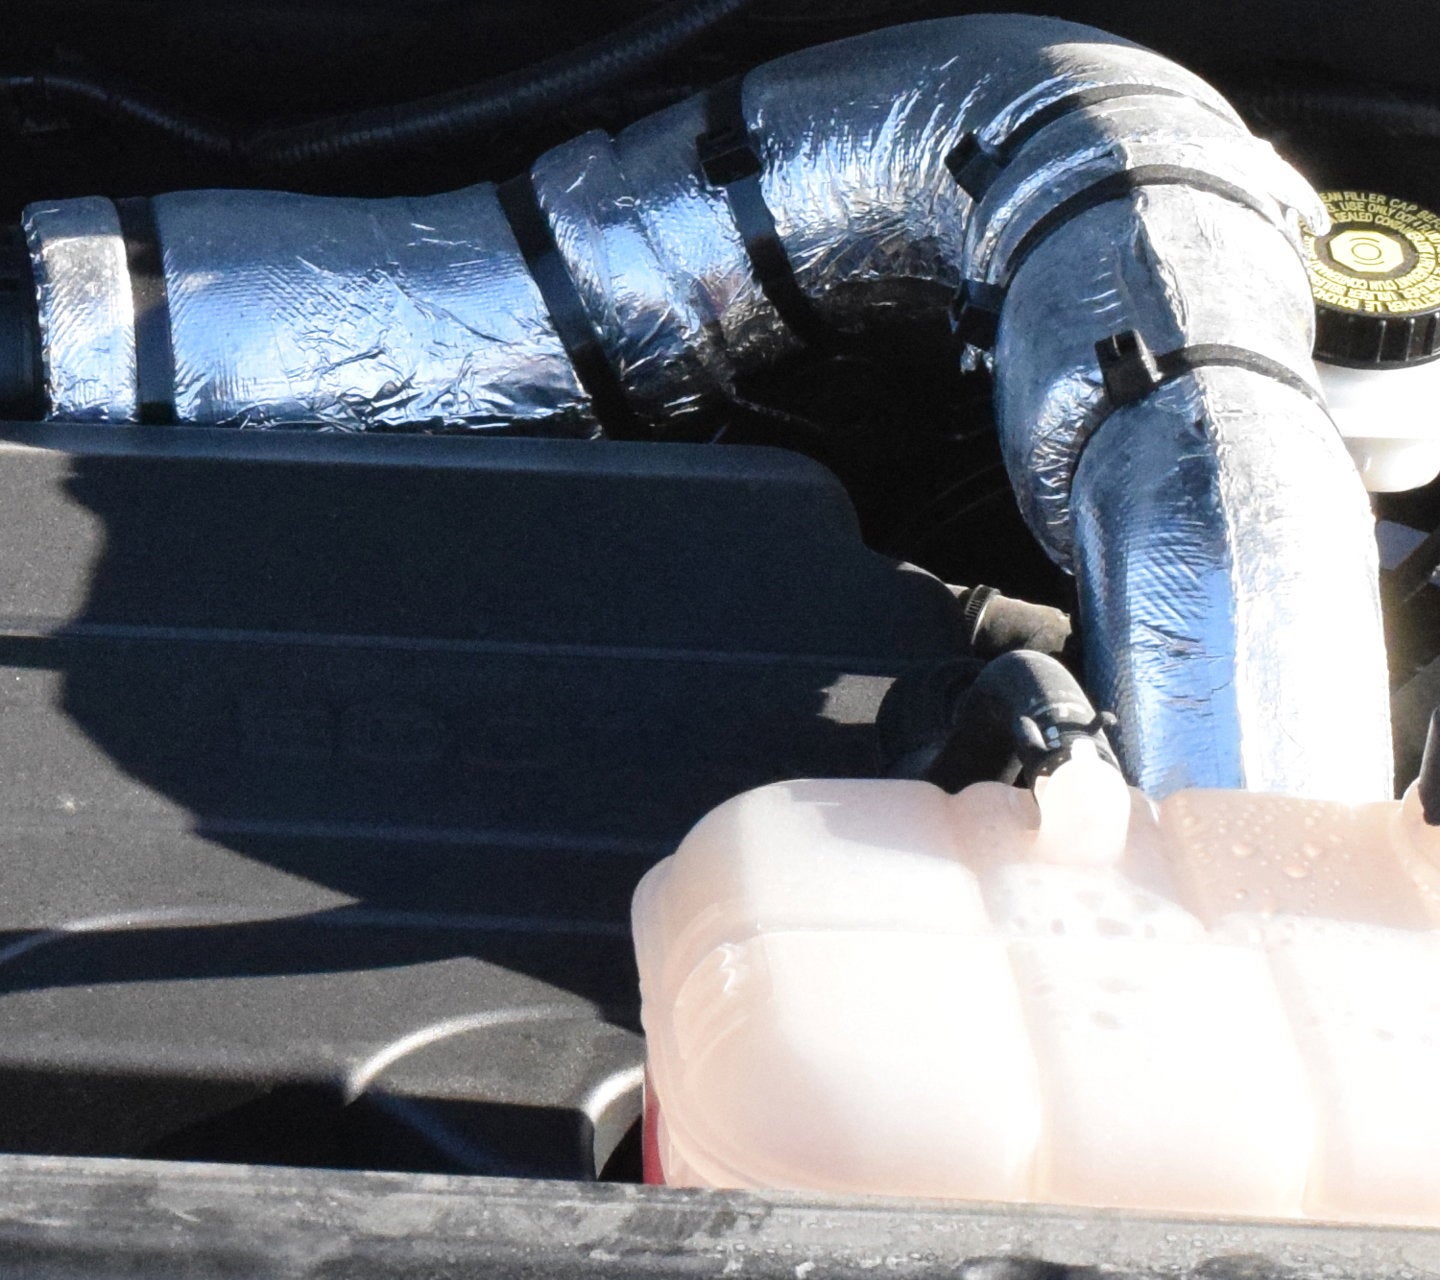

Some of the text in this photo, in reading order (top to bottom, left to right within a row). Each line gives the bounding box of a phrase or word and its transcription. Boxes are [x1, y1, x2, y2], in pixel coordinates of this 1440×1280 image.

[1339, 202, 1363, 211] USE
[1369, 203, 1395, 216] ONLY
[1395, 210, 1417, 223] DOT
[1343, 191, 1386, 204] FILLER
[1389, 197, 1418, 213] CAP
[1366, 300, 1381, 311] LE
